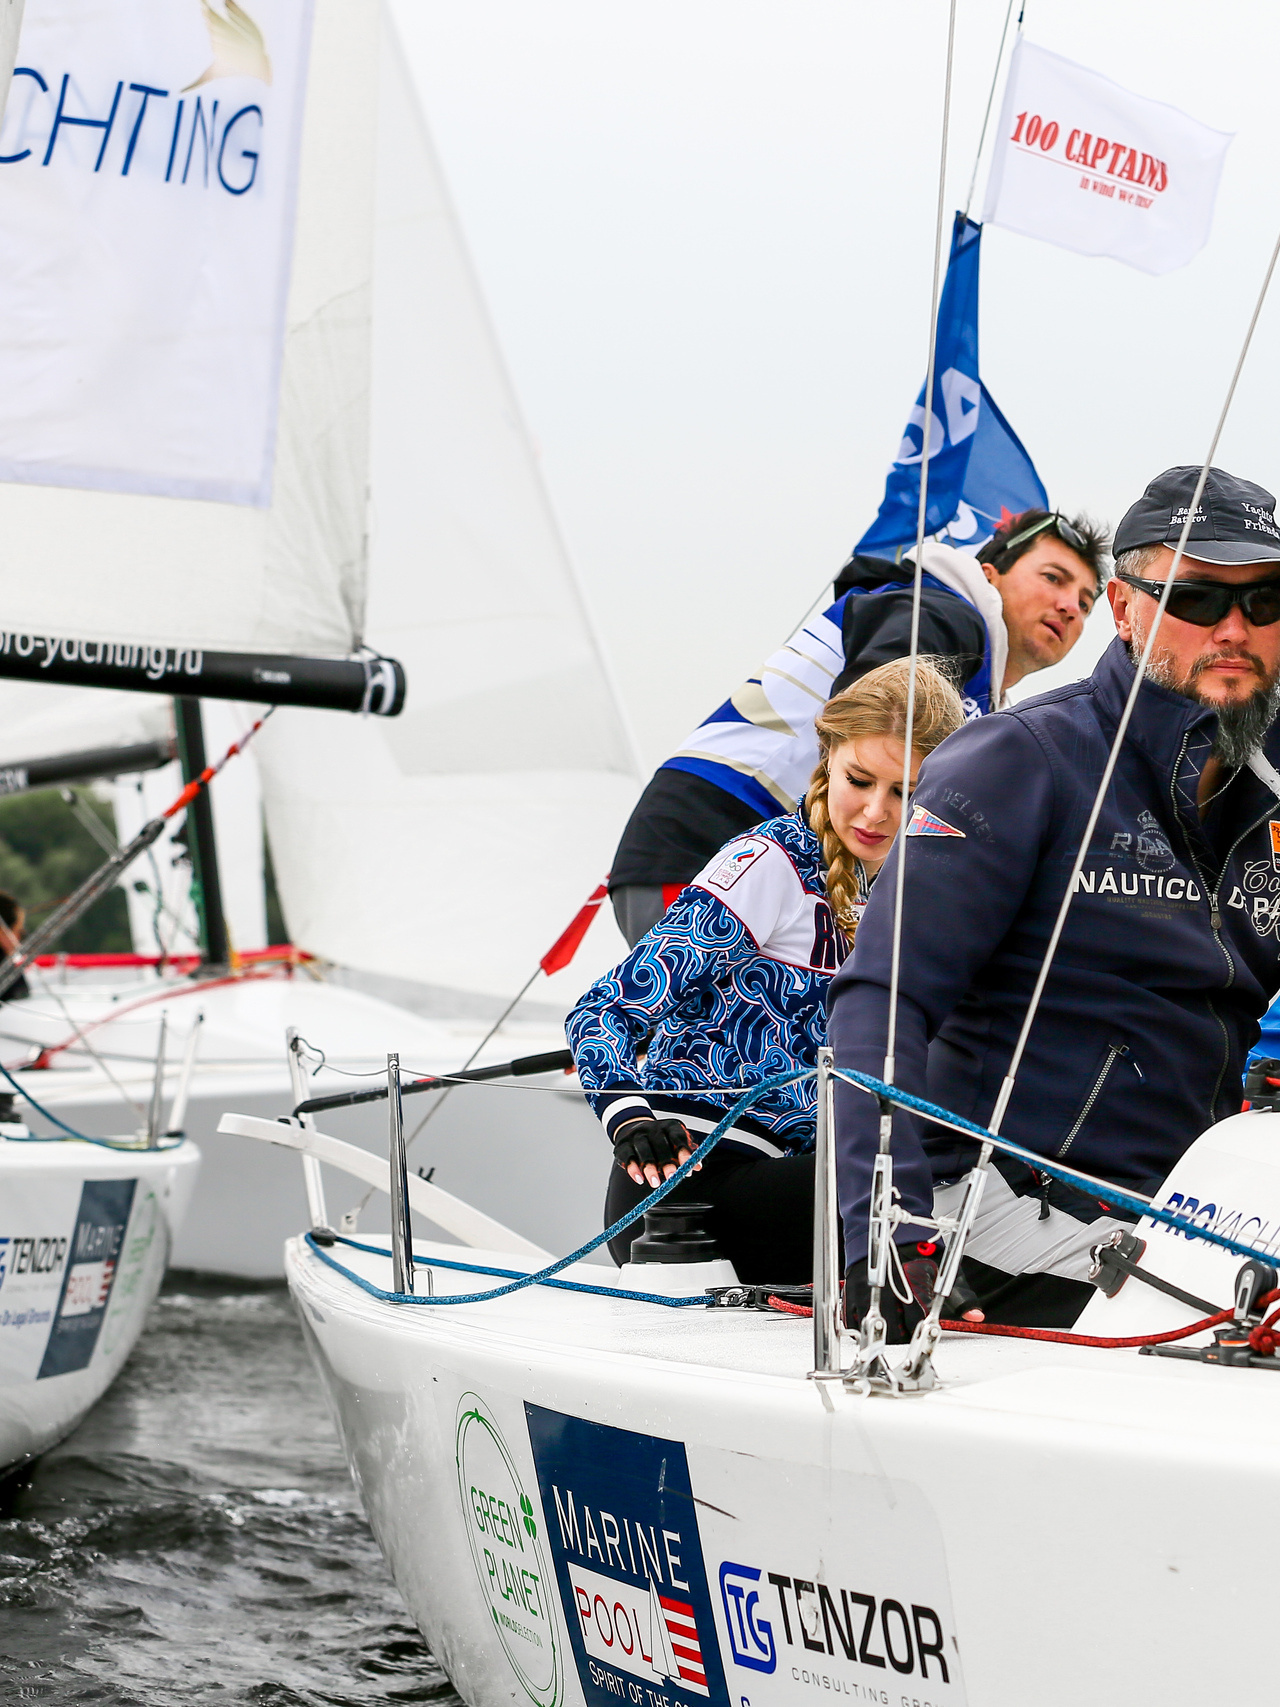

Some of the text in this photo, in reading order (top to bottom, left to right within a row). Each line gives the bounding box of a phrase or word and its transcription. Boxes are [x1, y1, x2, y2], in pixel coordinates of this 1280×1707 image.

[1010, 111, 1168, 192] 100 CAPTAINS
[1169, 515, 1207, 525] Batrov
[1177, 505, 1203, 516] Ret
[1241, 502, 1273, 523] Yachts
[1073, 867, 1201, 901] NÁUTICO
[470, 1486, 524, 1553] GREEN
[552, 1485, 691, 1594] MARINE
[484, 1548, 544, 1620] PLANET
[574, 1585, 654, 1664] POOL
[767, 1572, 950, 1684] TENZOR
[588, 1660, 626, 1698] SPIRIT
[628, 1681, 643, 1706] OF
[792, 1667, 889, 1705] CONSULTING
